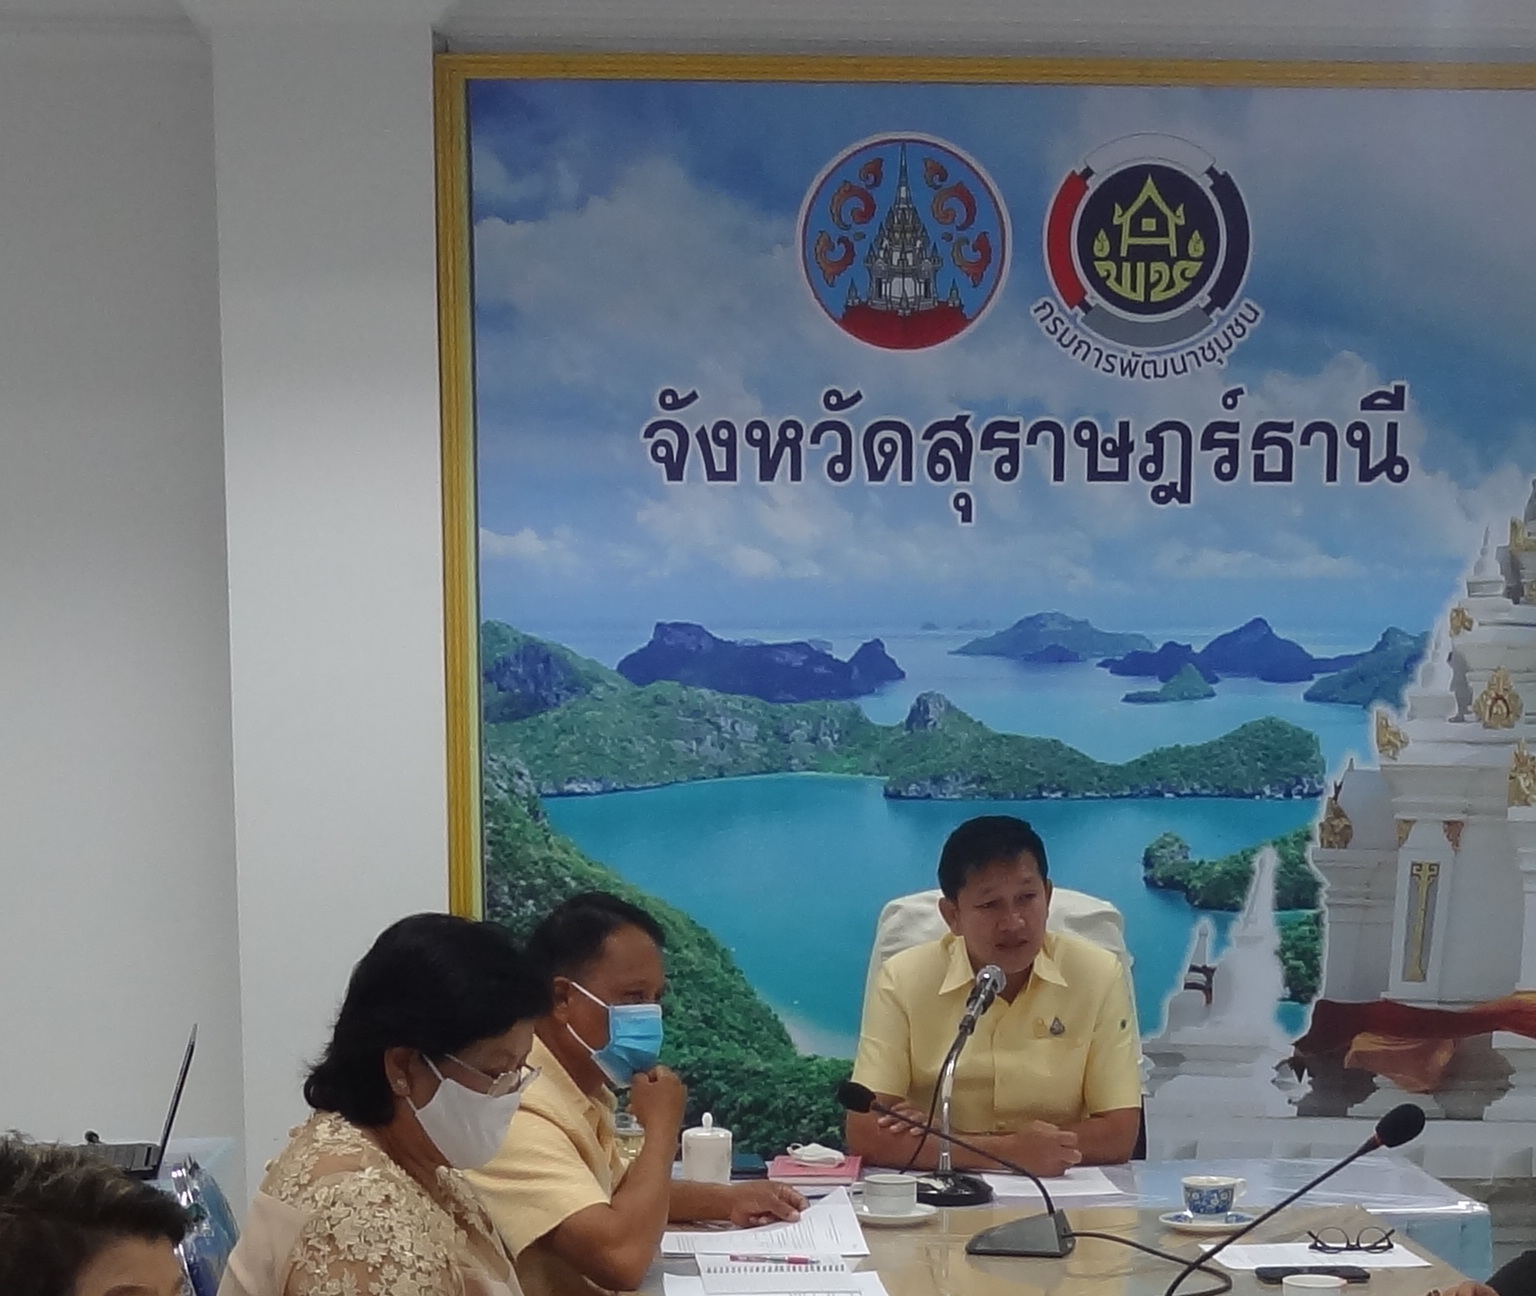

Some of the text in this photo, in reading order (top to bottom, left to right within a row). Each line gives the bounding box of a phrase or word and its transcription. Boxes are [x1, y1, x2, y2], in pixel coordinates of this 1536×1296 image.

[1033, 299, 1262, 380] กรมการพัฒนาชุมชน
[642, 384, 1410, 524] จังหวัดสุราษฎร์ธานี
